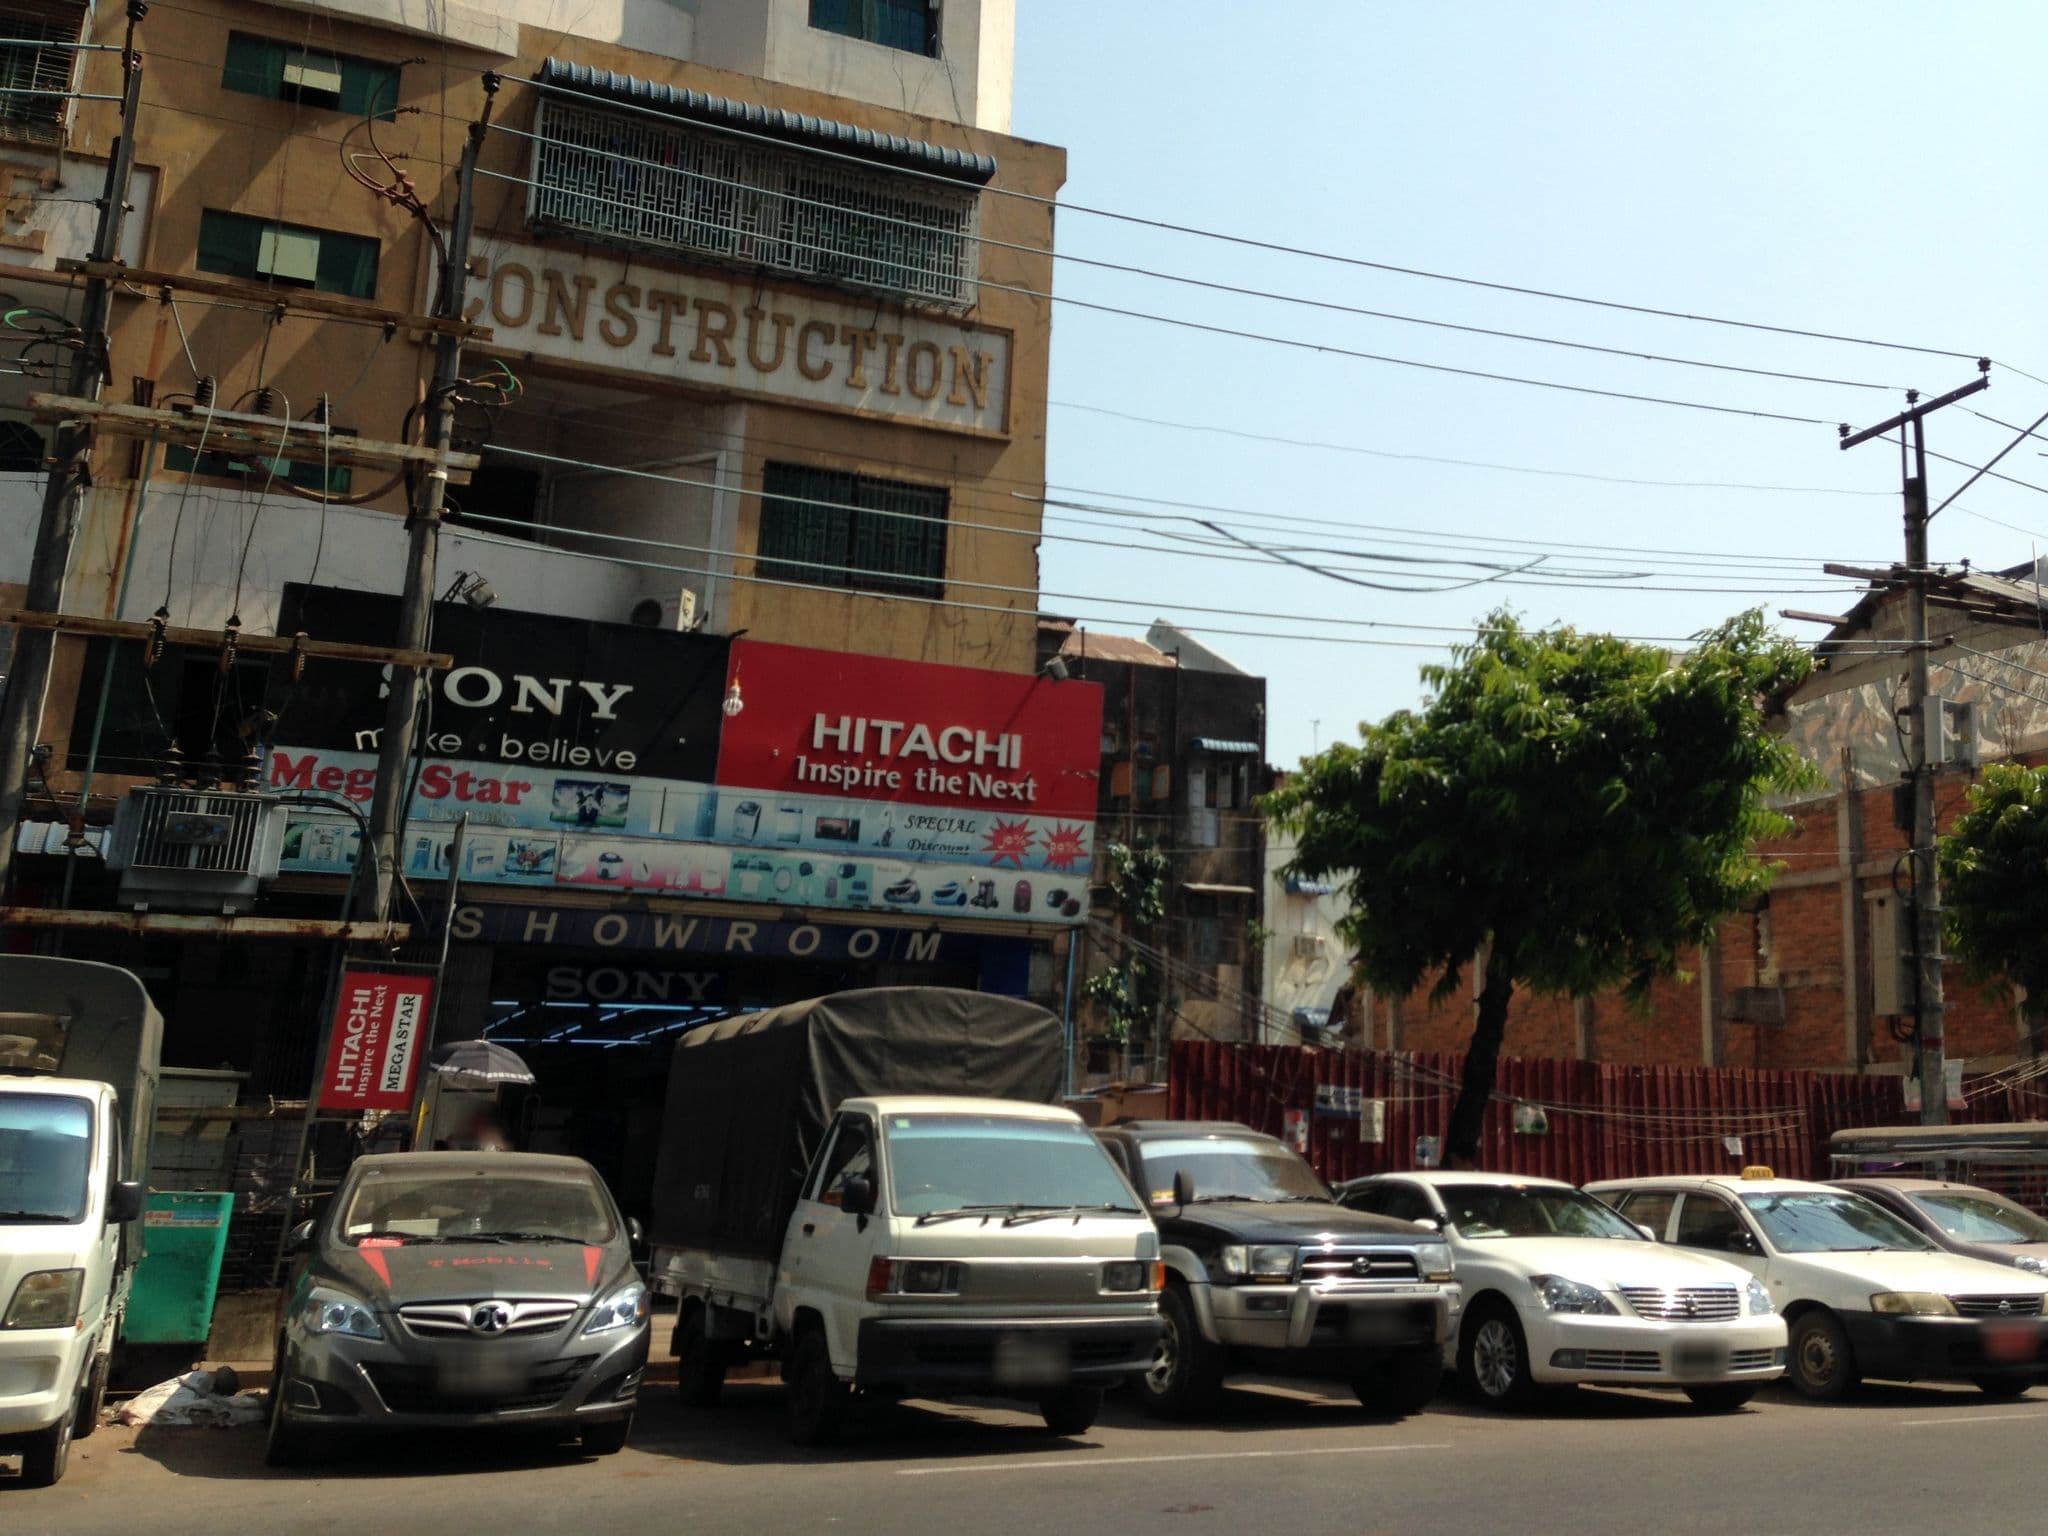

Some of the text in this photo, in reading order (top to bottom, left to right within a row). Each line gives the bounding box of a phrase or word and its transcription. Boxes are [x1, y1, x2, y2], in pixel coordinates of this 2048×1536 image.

[355, 728, 638, 771] mke believe
[812, 712, 1022, 769] HITACHI
[269, 752, 532, 806] Meg Star
[797, 755, 1038, 802] Inspire the Next
[904, 814, 976, 834] SPECIAL
[907, 838, 970, 857] Discount
[546, 965, 719, 1001] SONY
[334, 989, 372, 1092] HITACHI
[354, 985, 388, 1098] Inspire the Next
